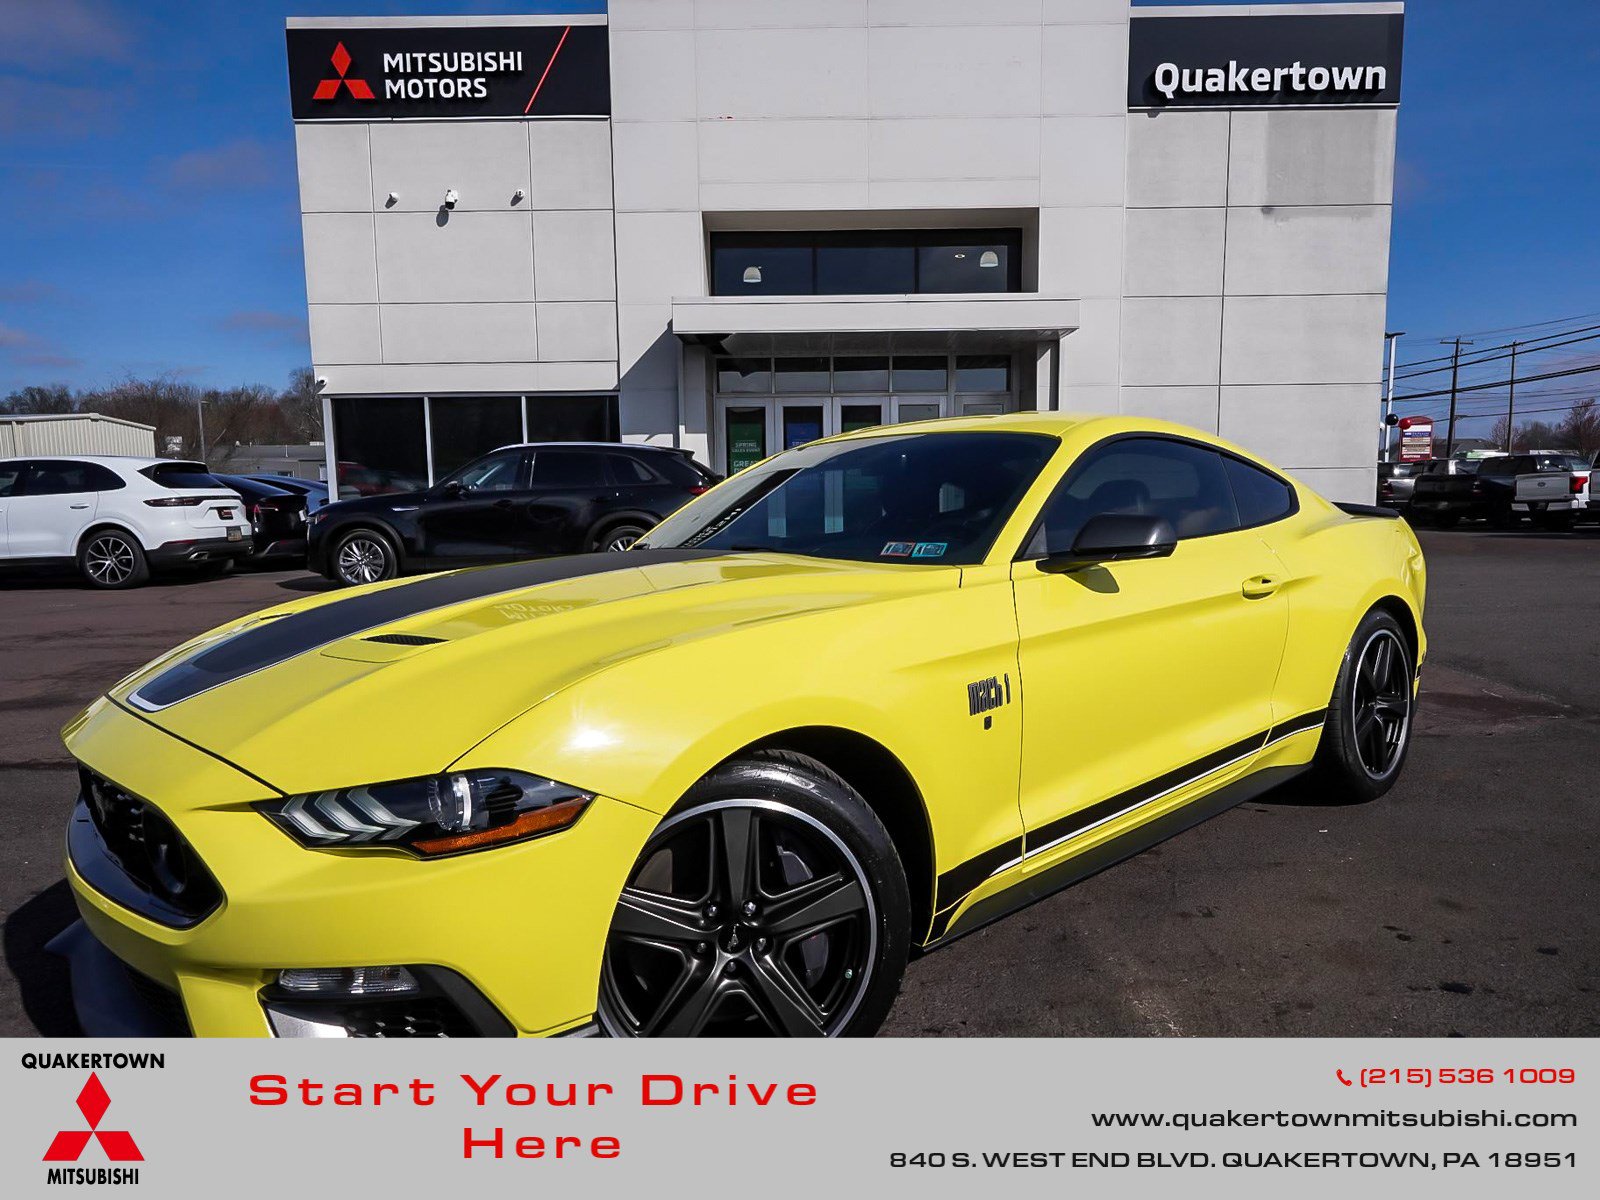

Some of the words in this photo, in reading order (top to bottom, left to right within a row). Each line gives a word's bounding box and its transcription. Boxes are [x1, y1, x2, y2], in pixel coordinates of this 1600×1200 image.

[383, 51, 523, 73] MITSUBISHI
[385, 78, 488, 99] MOTORS
[1154, 60, 1387, 99] Quakertown
